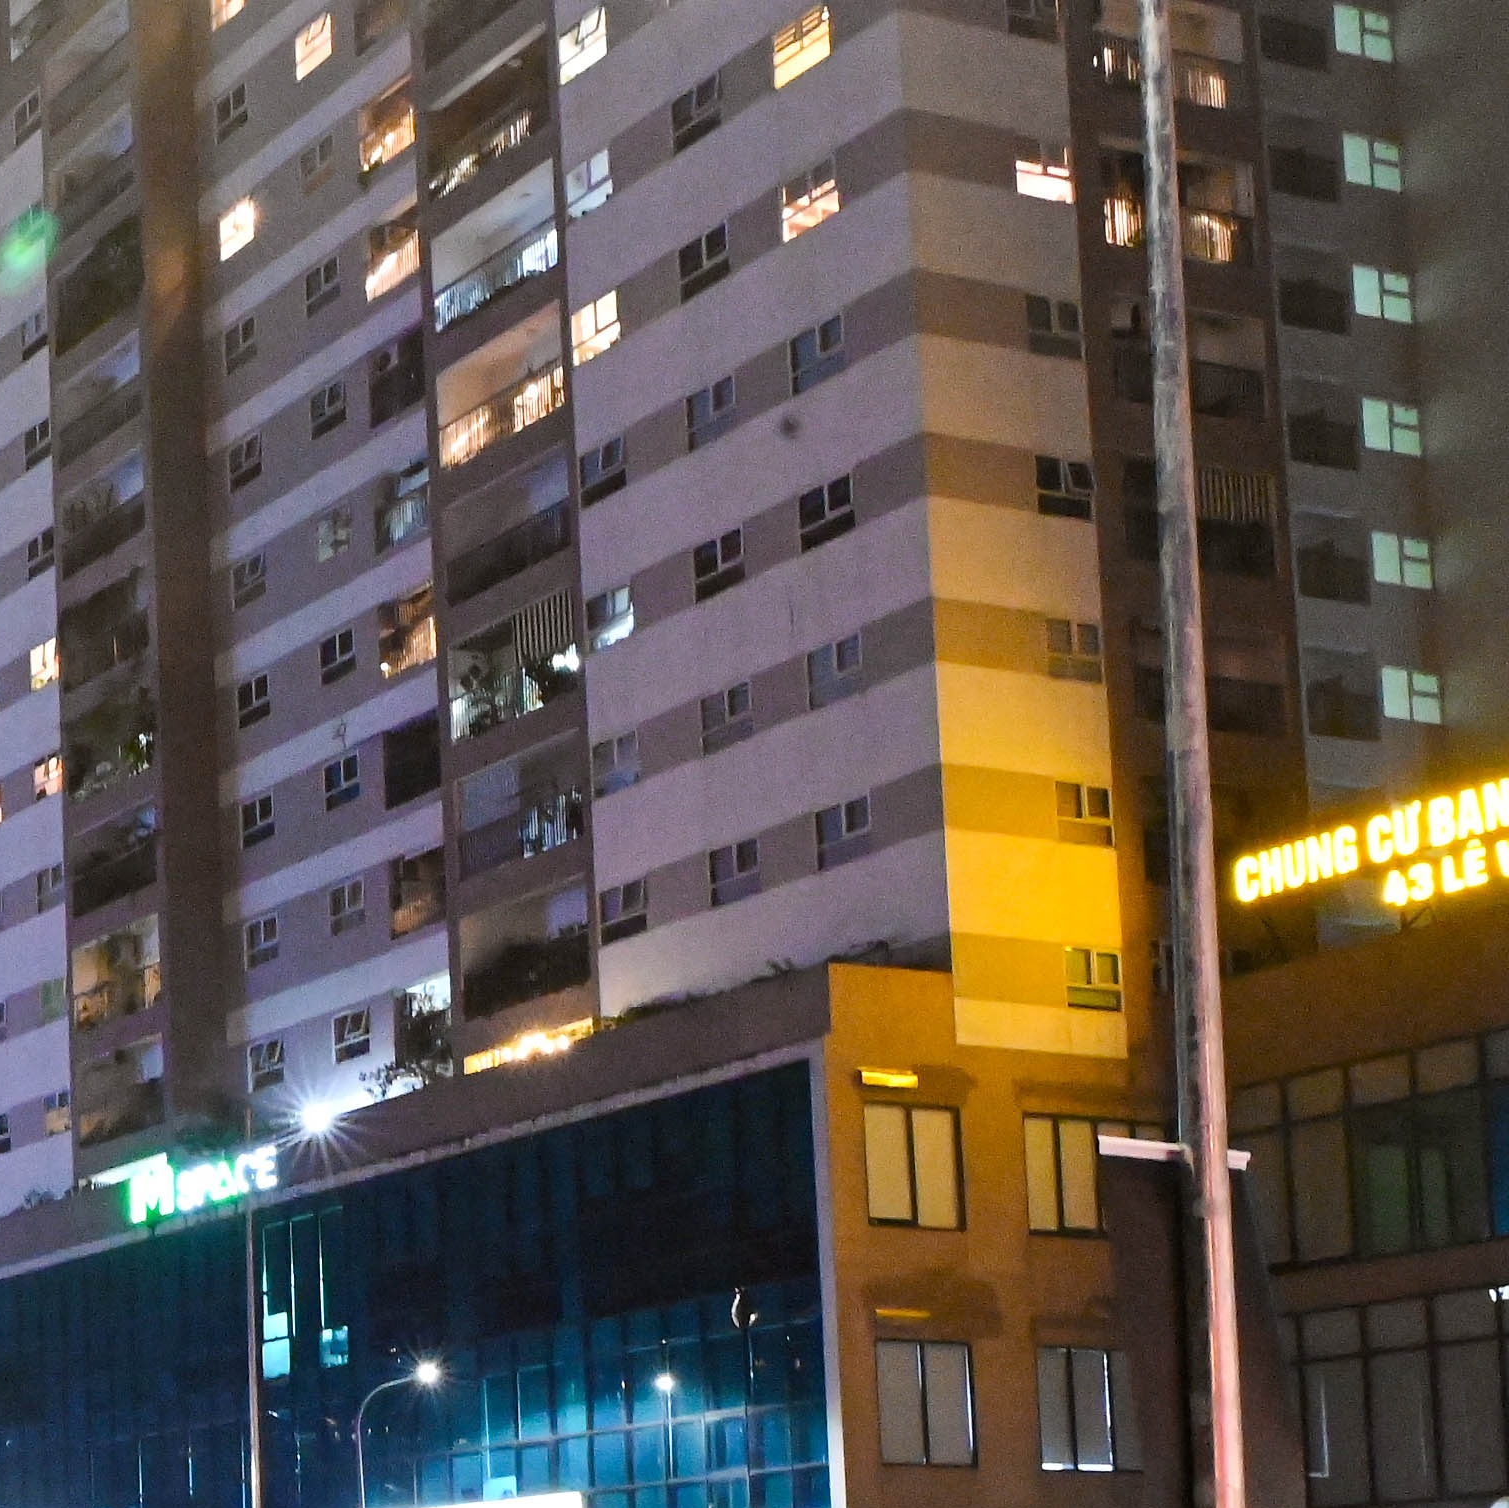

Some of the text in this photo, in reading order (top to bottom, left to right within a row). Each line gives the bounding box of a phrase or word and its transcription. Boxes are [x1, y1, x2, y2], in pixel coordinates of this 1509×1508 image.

[1233, 824, 1359, 903] CHUNG
[1365, 799, 1422, 864] CƯ
[1427, 777, 1509, 847] BAN
[1382, 862, 1435, 907] 43
[1440, 838, 1490, 894] LÊ
